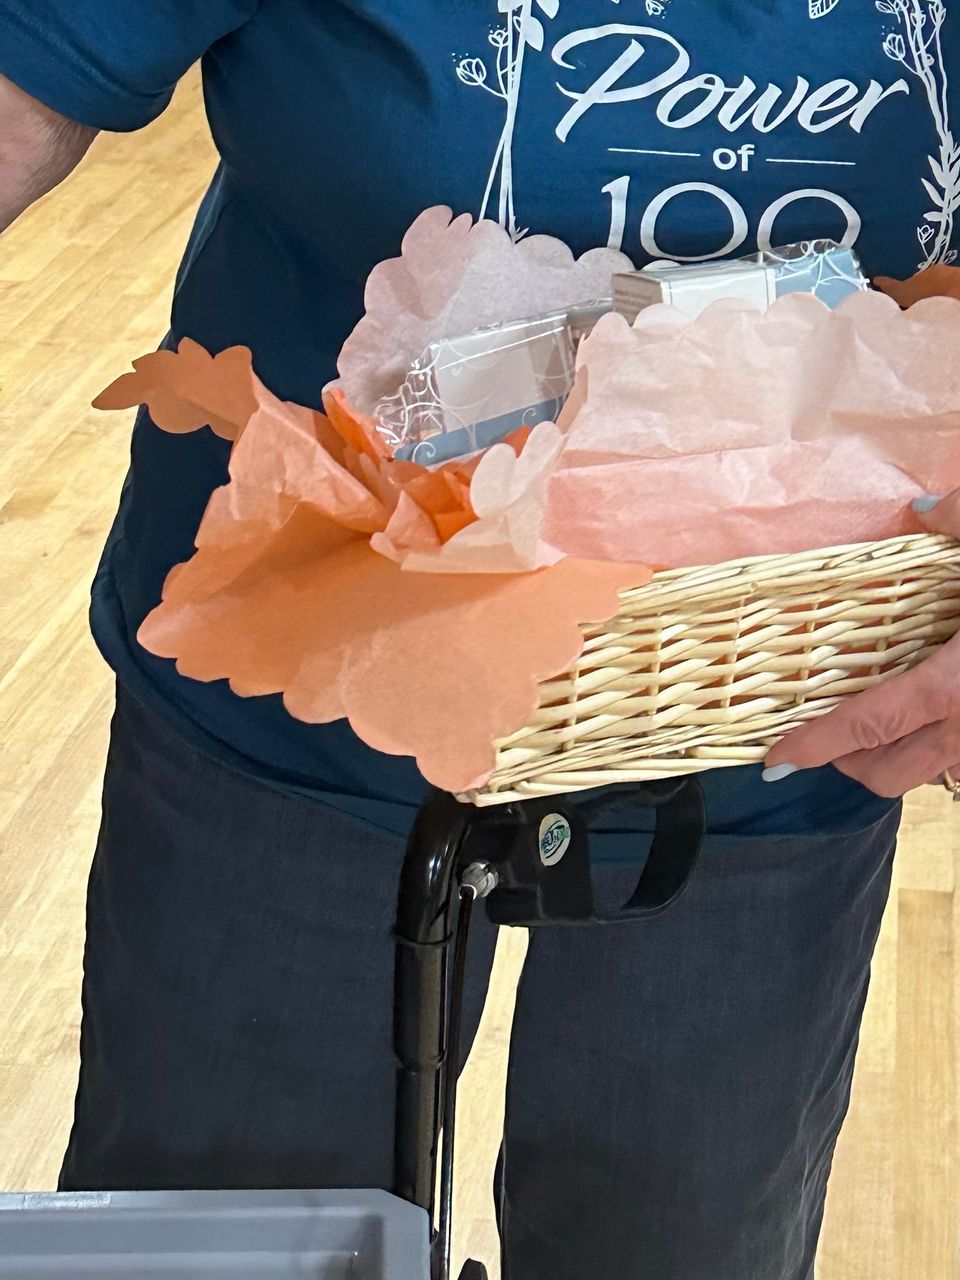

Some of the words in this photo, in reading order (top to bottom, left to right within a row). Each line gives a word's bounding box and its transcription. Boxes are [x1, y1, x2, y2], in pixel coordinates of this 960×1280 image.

[550, 22, 910, 143] Power
[712, 144, 755, 171] of
[600, 174, 862, 263] 100
